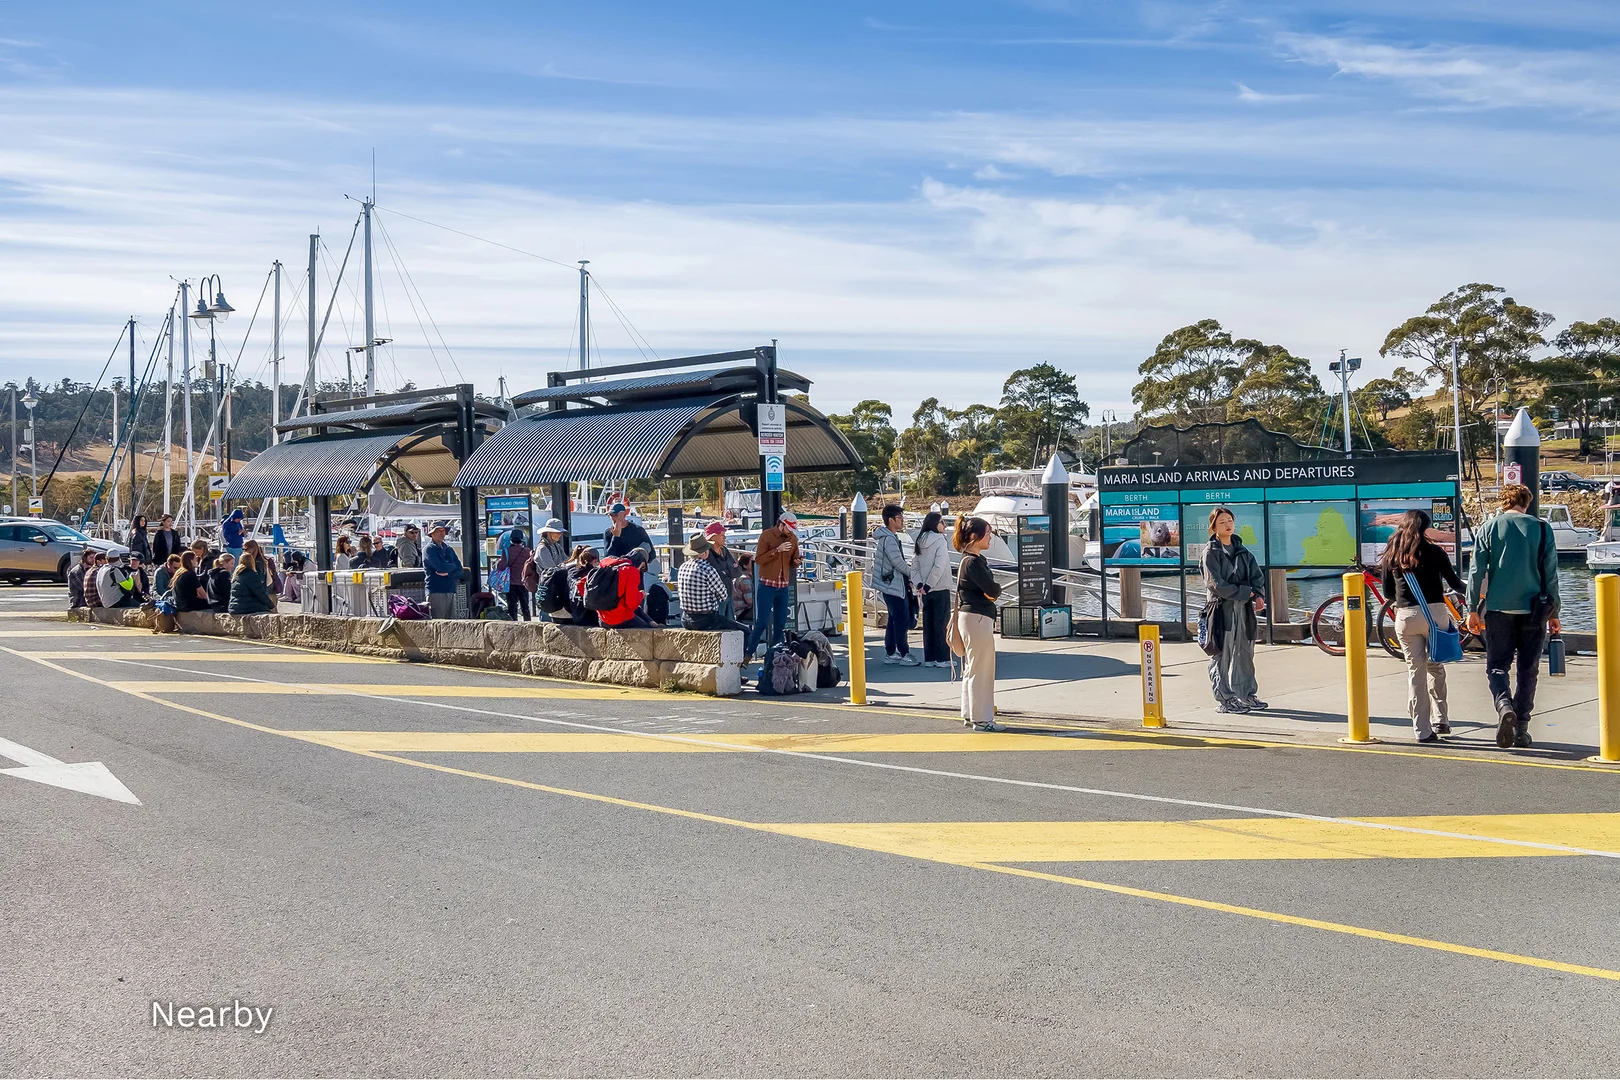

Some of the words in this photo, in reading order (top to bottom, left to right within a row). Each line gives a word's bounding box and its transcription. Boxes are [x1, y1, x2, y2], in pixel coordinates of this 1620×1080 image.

[1103, 474, 1138, 485] MARIA
[1141, 472, 1182, 484] ISLAND
[1185, 470, 1240, 482] ARRIVALS
[1243, 468, 1271, 481] AND
[1275, 465, 1355, 480] DEPARTURES
[1124, 494, 1148, 502] BERTH
[1205, 492, 1231, 500] BERTH
[1105, 508, 1131, 517] MARIA
[1131, 508, 1160, 516] ISLAND
[1146, 654, 1152, 664] NO
